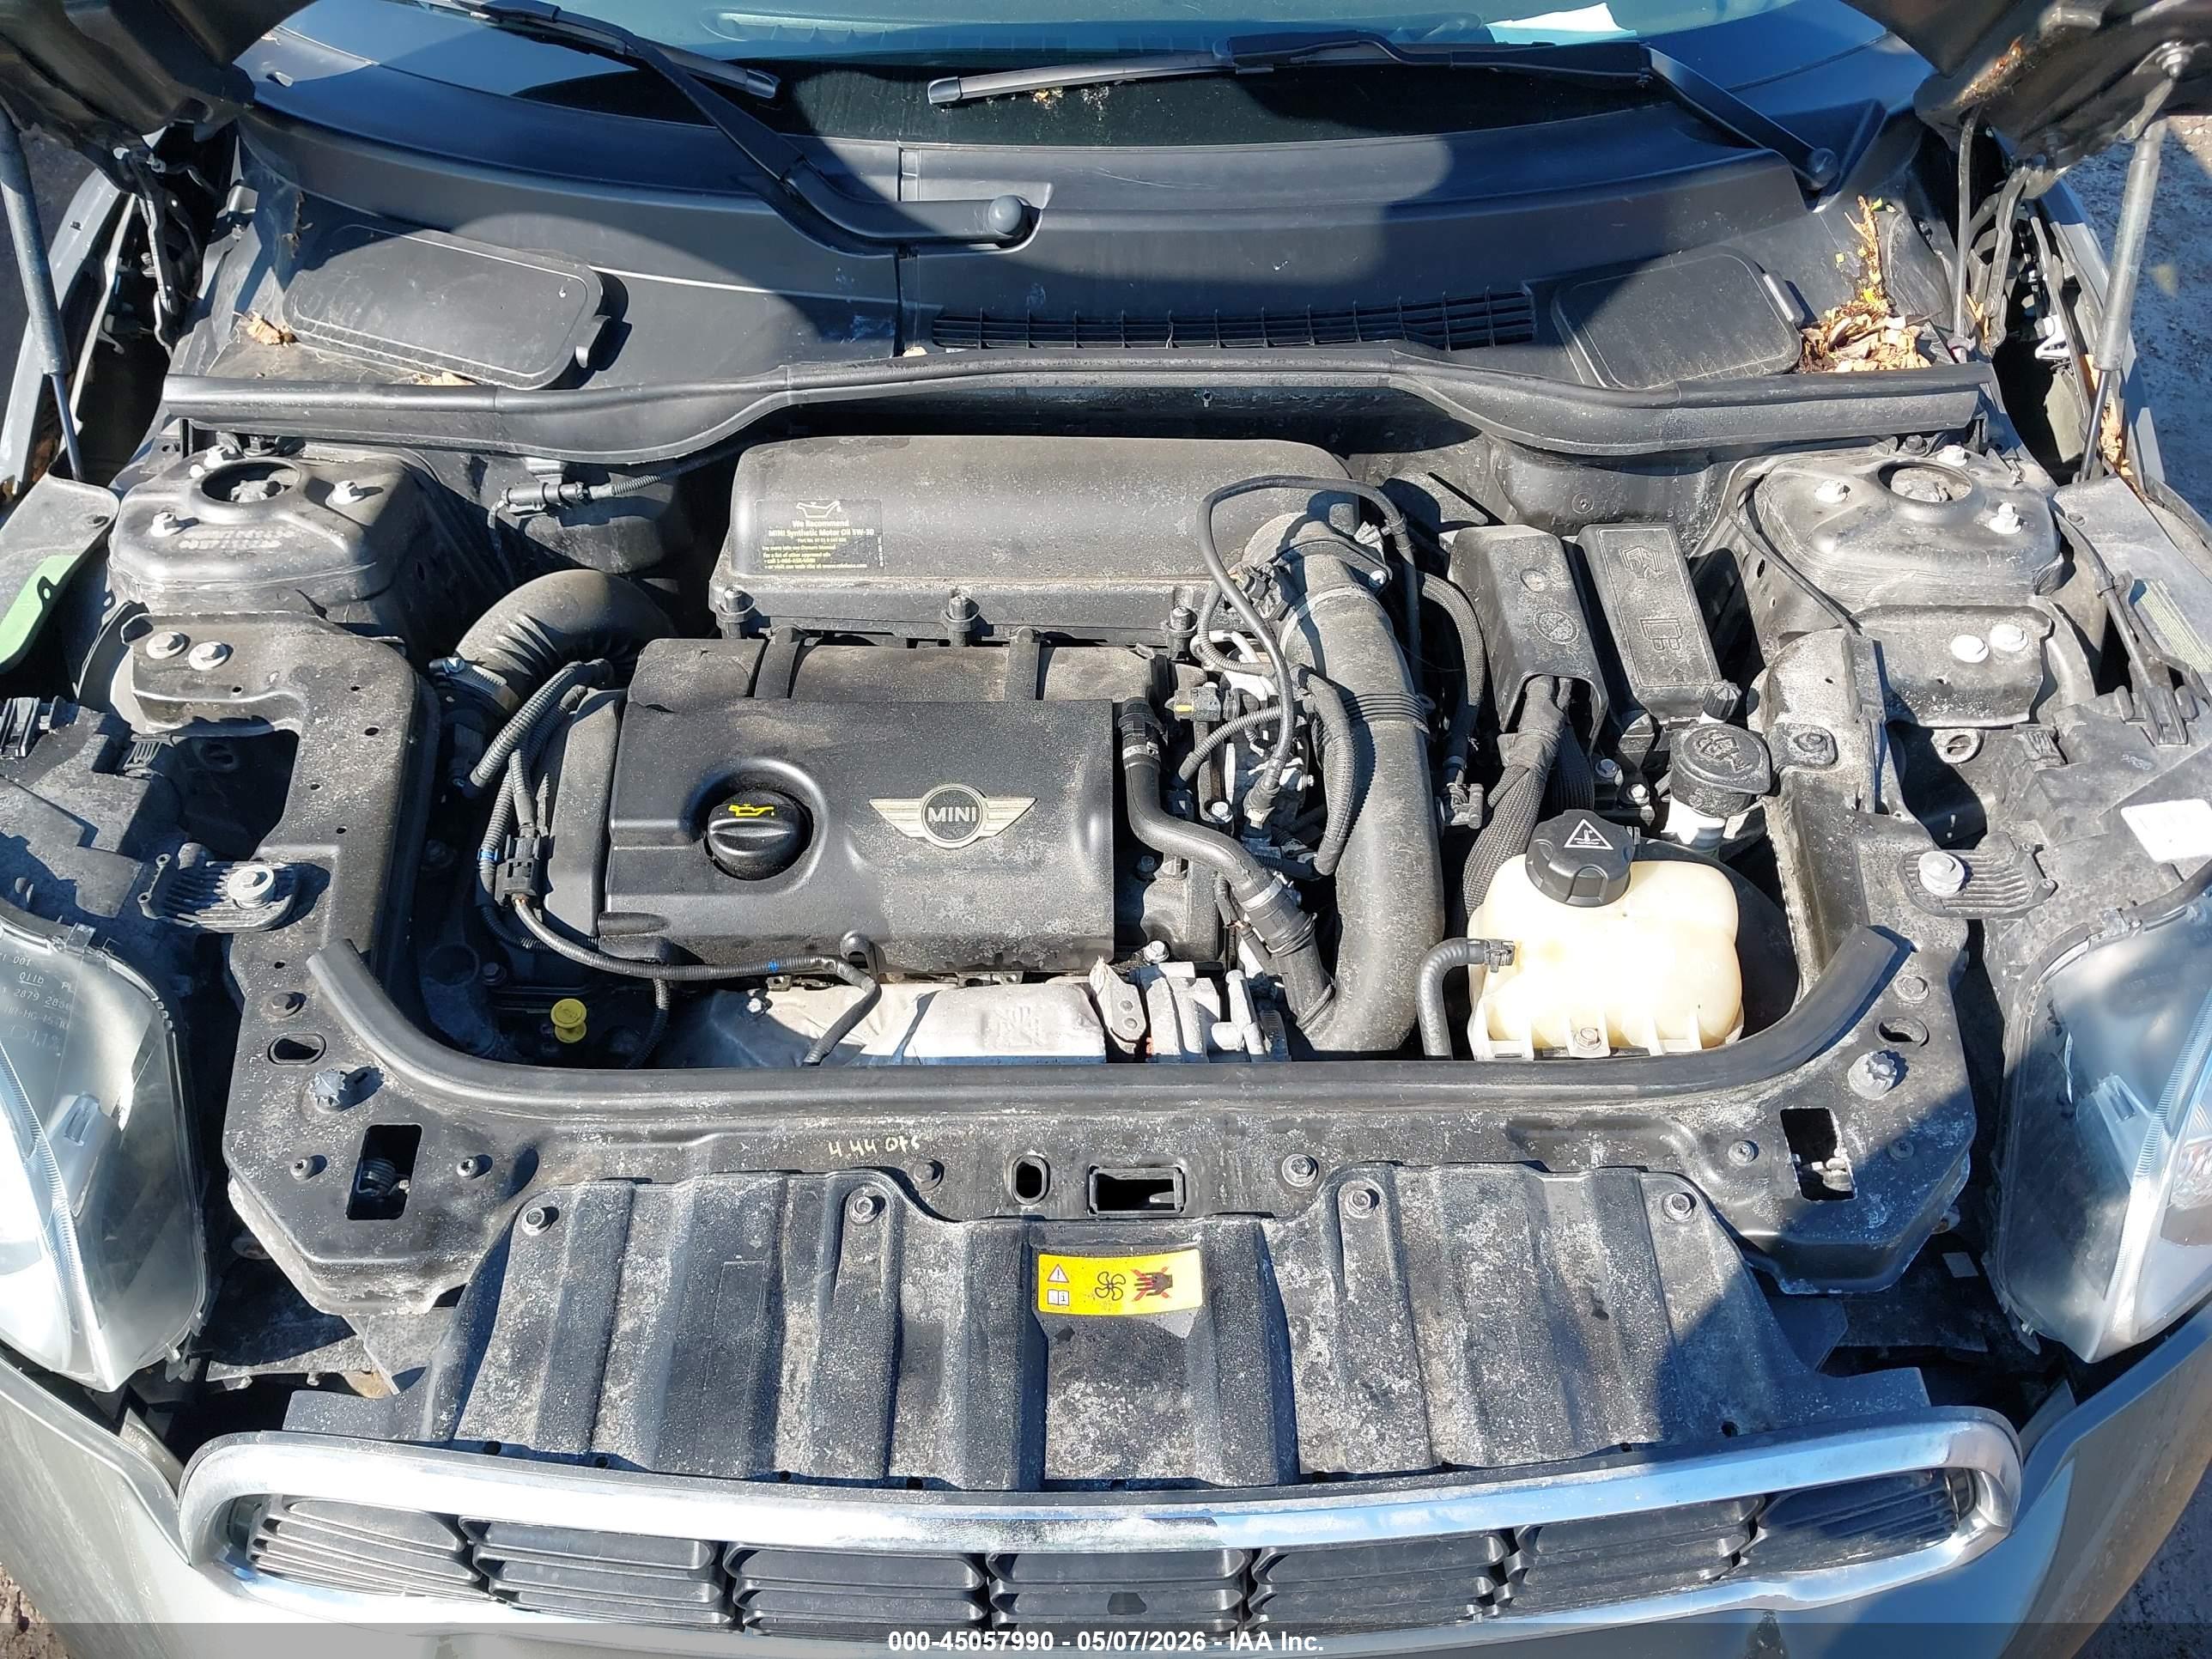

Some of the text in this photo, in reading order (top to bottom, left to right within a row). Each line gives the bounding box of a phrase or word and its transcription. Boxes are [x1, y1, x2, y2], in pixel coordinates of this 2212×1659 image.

[805, 519, 849, 527] Recommend
[787, 528, 818, 539] Synthetic
[819, 528, 840, 537] Motor
[851, 528, 875, 537] 5W-30
[927, 806, 977, 823] MINI
